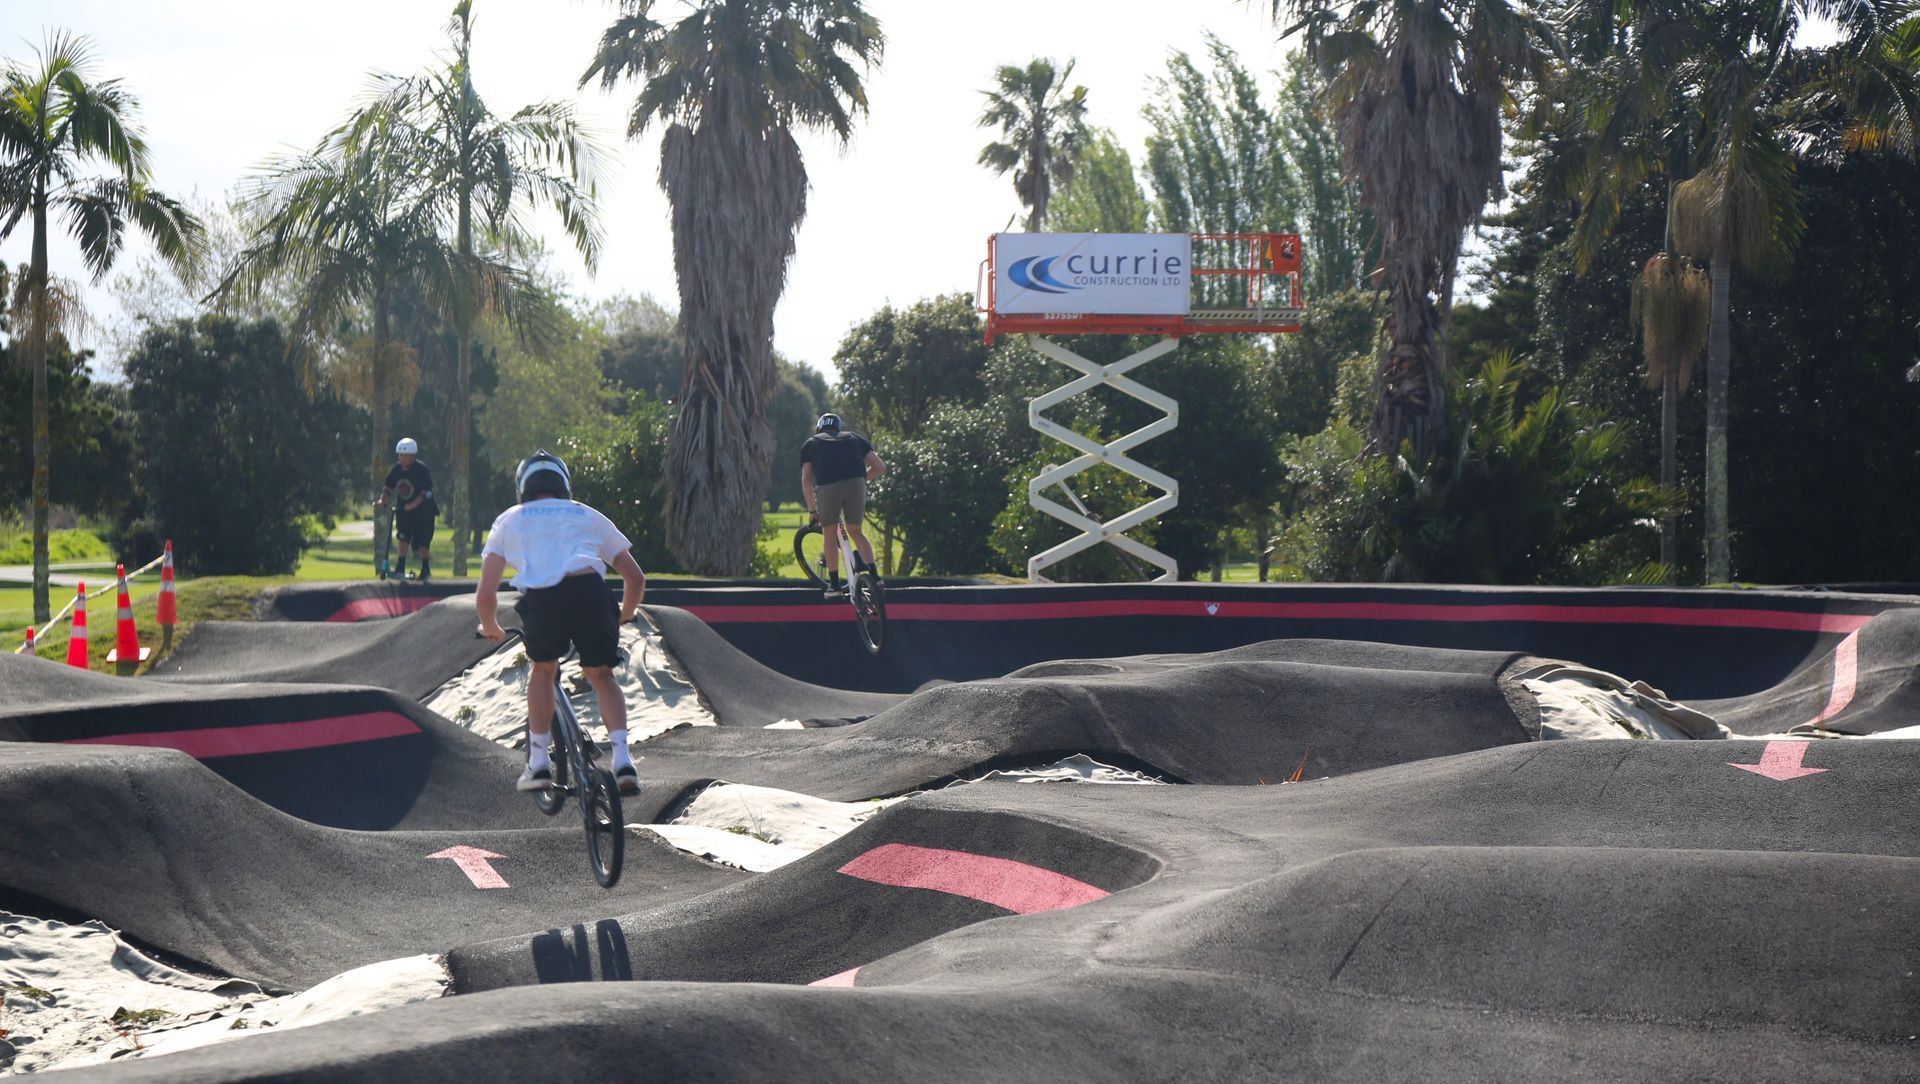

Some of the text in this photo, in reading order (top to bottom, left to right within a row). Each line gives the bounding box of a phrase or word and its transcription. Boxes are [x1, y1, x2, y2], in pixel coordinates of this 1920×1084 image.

[1067, 248, 1181, 275] currie
[1073, 276, 1181, 286] CONSTRUCTION LTD
